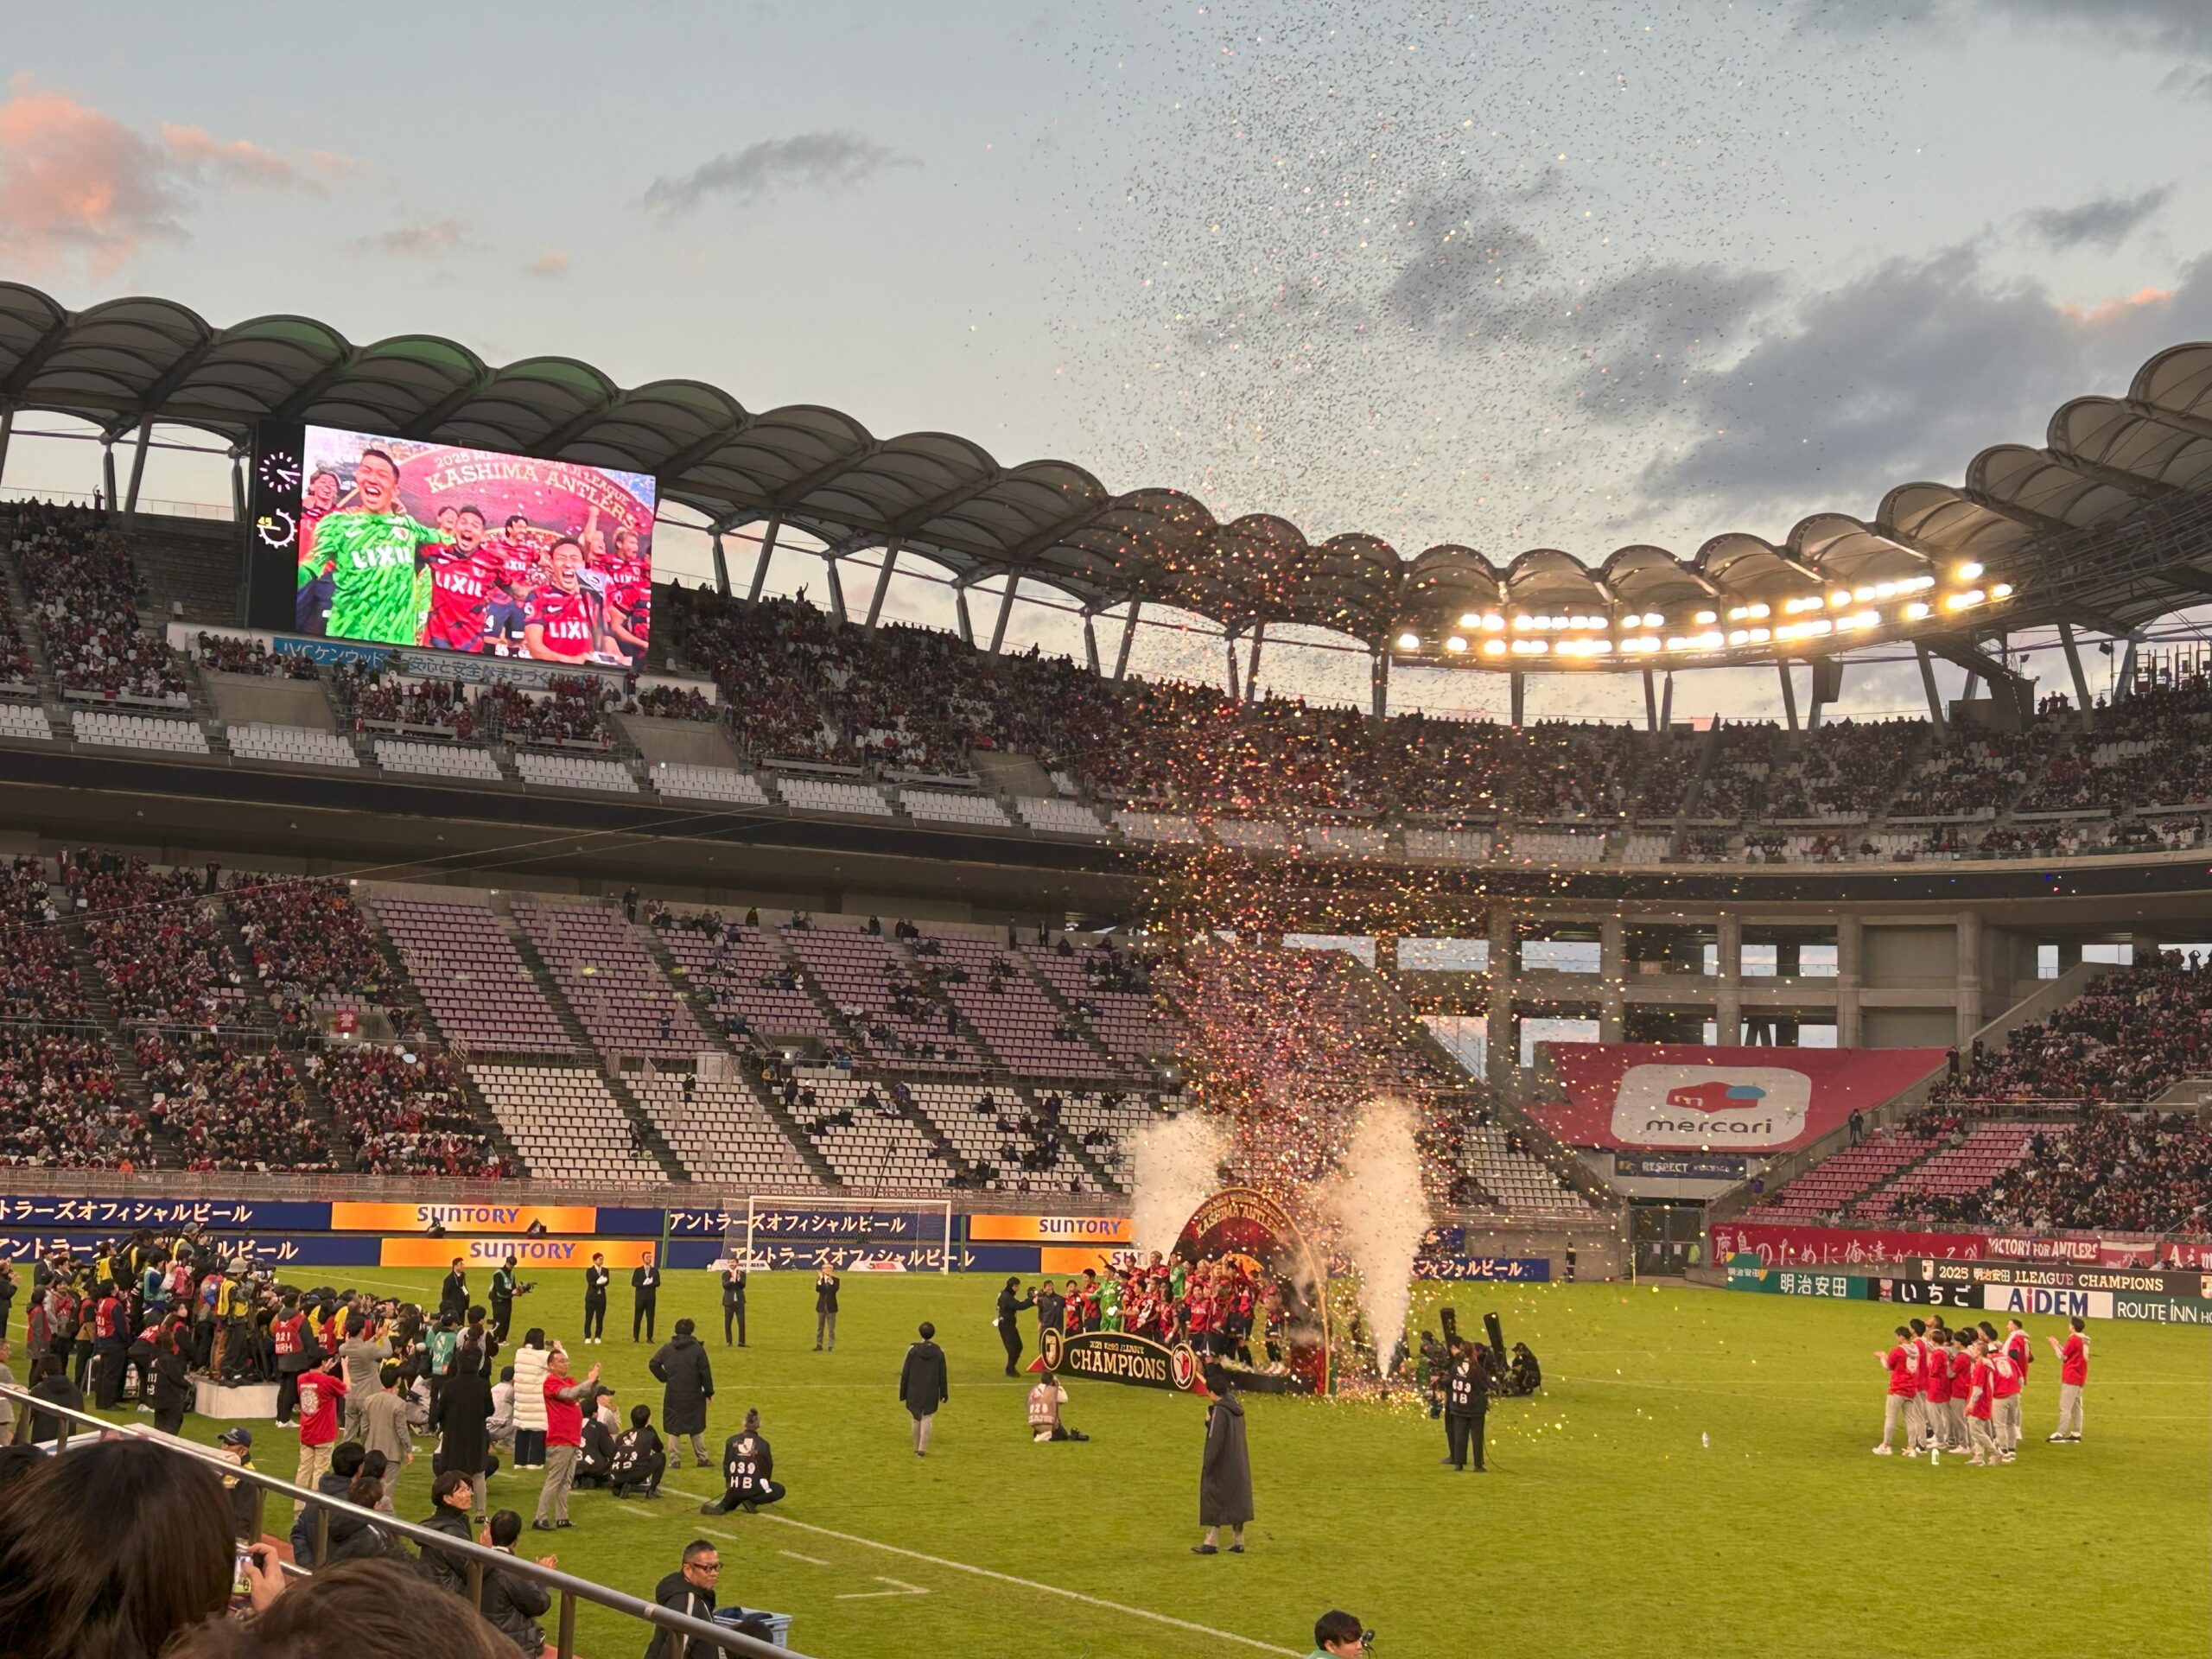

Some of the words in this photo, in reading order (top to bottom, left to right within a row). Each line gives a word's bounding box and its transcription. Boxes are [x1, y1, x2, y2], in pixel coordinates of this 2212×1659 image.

[423, 462, 539, 493] KASHIMA
[544, 470, 638, 530] ANTLERS
[435, 570, 484, 598] LIXIL
[548, 621, 591, 639] LIXI
[1646, 1118, 1772, 1134] mercari
[1643, 1161, 1689, 1173] RESPECT
[417, 1206, 520, 1224] SUNTORY
[1039, 1218, 1122, 1236] SUNTORY
[469, 1242, 576, 1260] SUNTORY
[1988, 1236, 2031, 1257] VICTORY
[2033, 1242, 2050, 1257] FOR
[1780, 1273, 1847, 1297] 明治安田
[1939, 1266, 1969, 1280] 2025
[2078, 1274, 2164, 1292] CHAMPIONS
[1901, 1282, 1972, 1307] いちご
[2117, 1301, 2166, 1320] ROUTE
[1070, 1348, 1166, 1382] CHAMPIONS
[729, 1461, 756, 1474] 039
